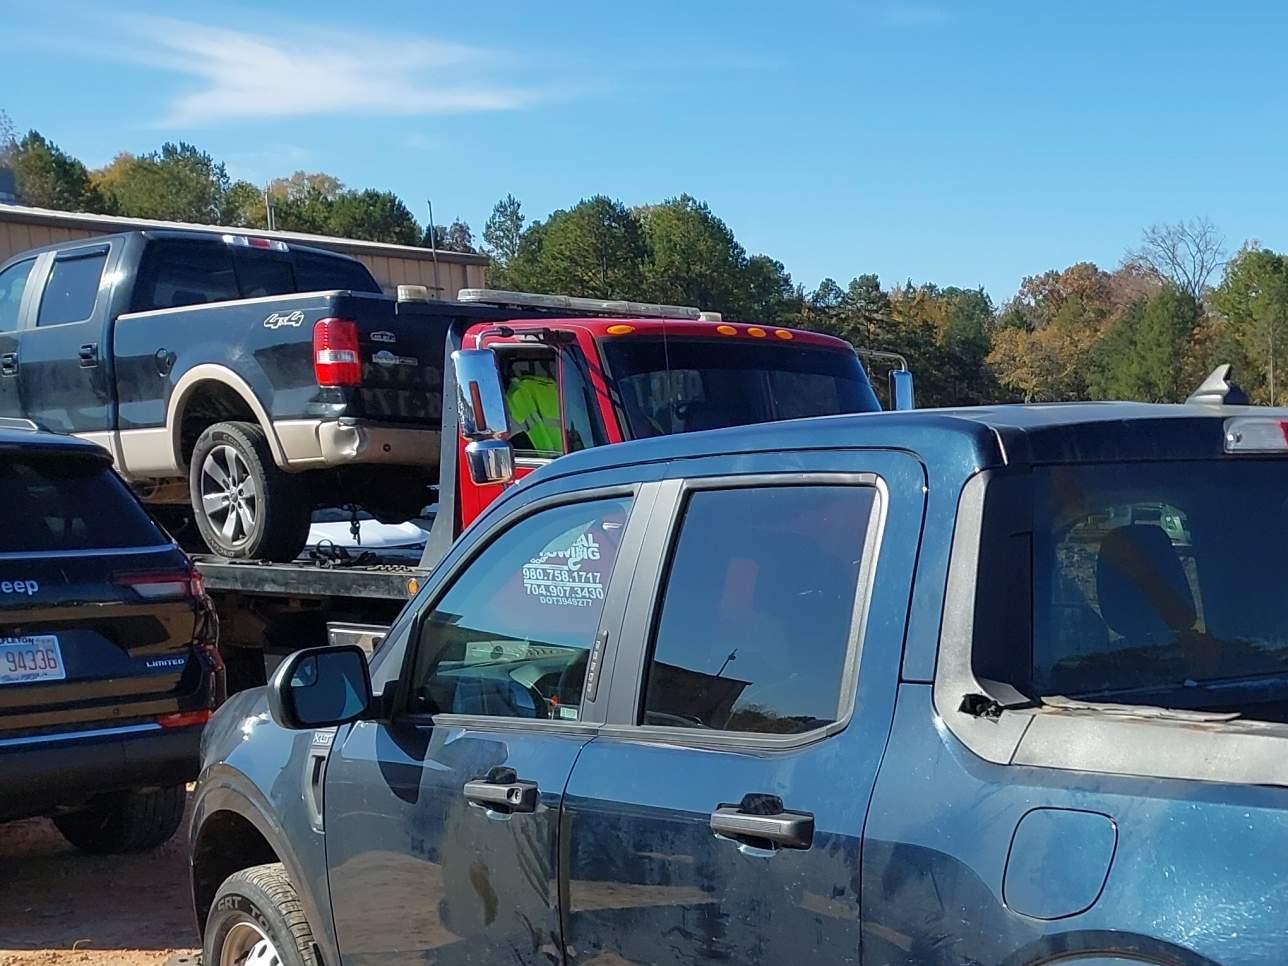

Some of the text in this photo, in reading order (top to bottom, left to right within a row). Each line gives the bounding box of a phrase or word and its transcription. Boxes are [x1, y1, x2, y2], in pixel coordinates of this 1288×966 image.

[522, 567, 601, 583] 980.758.1717
[0, 579, 39, 596] eep
[523, 583, 604, 600] 704.907.3430
[6, 648, 58, 672] 94336
[146, 658, 185, 668] LIMITED
